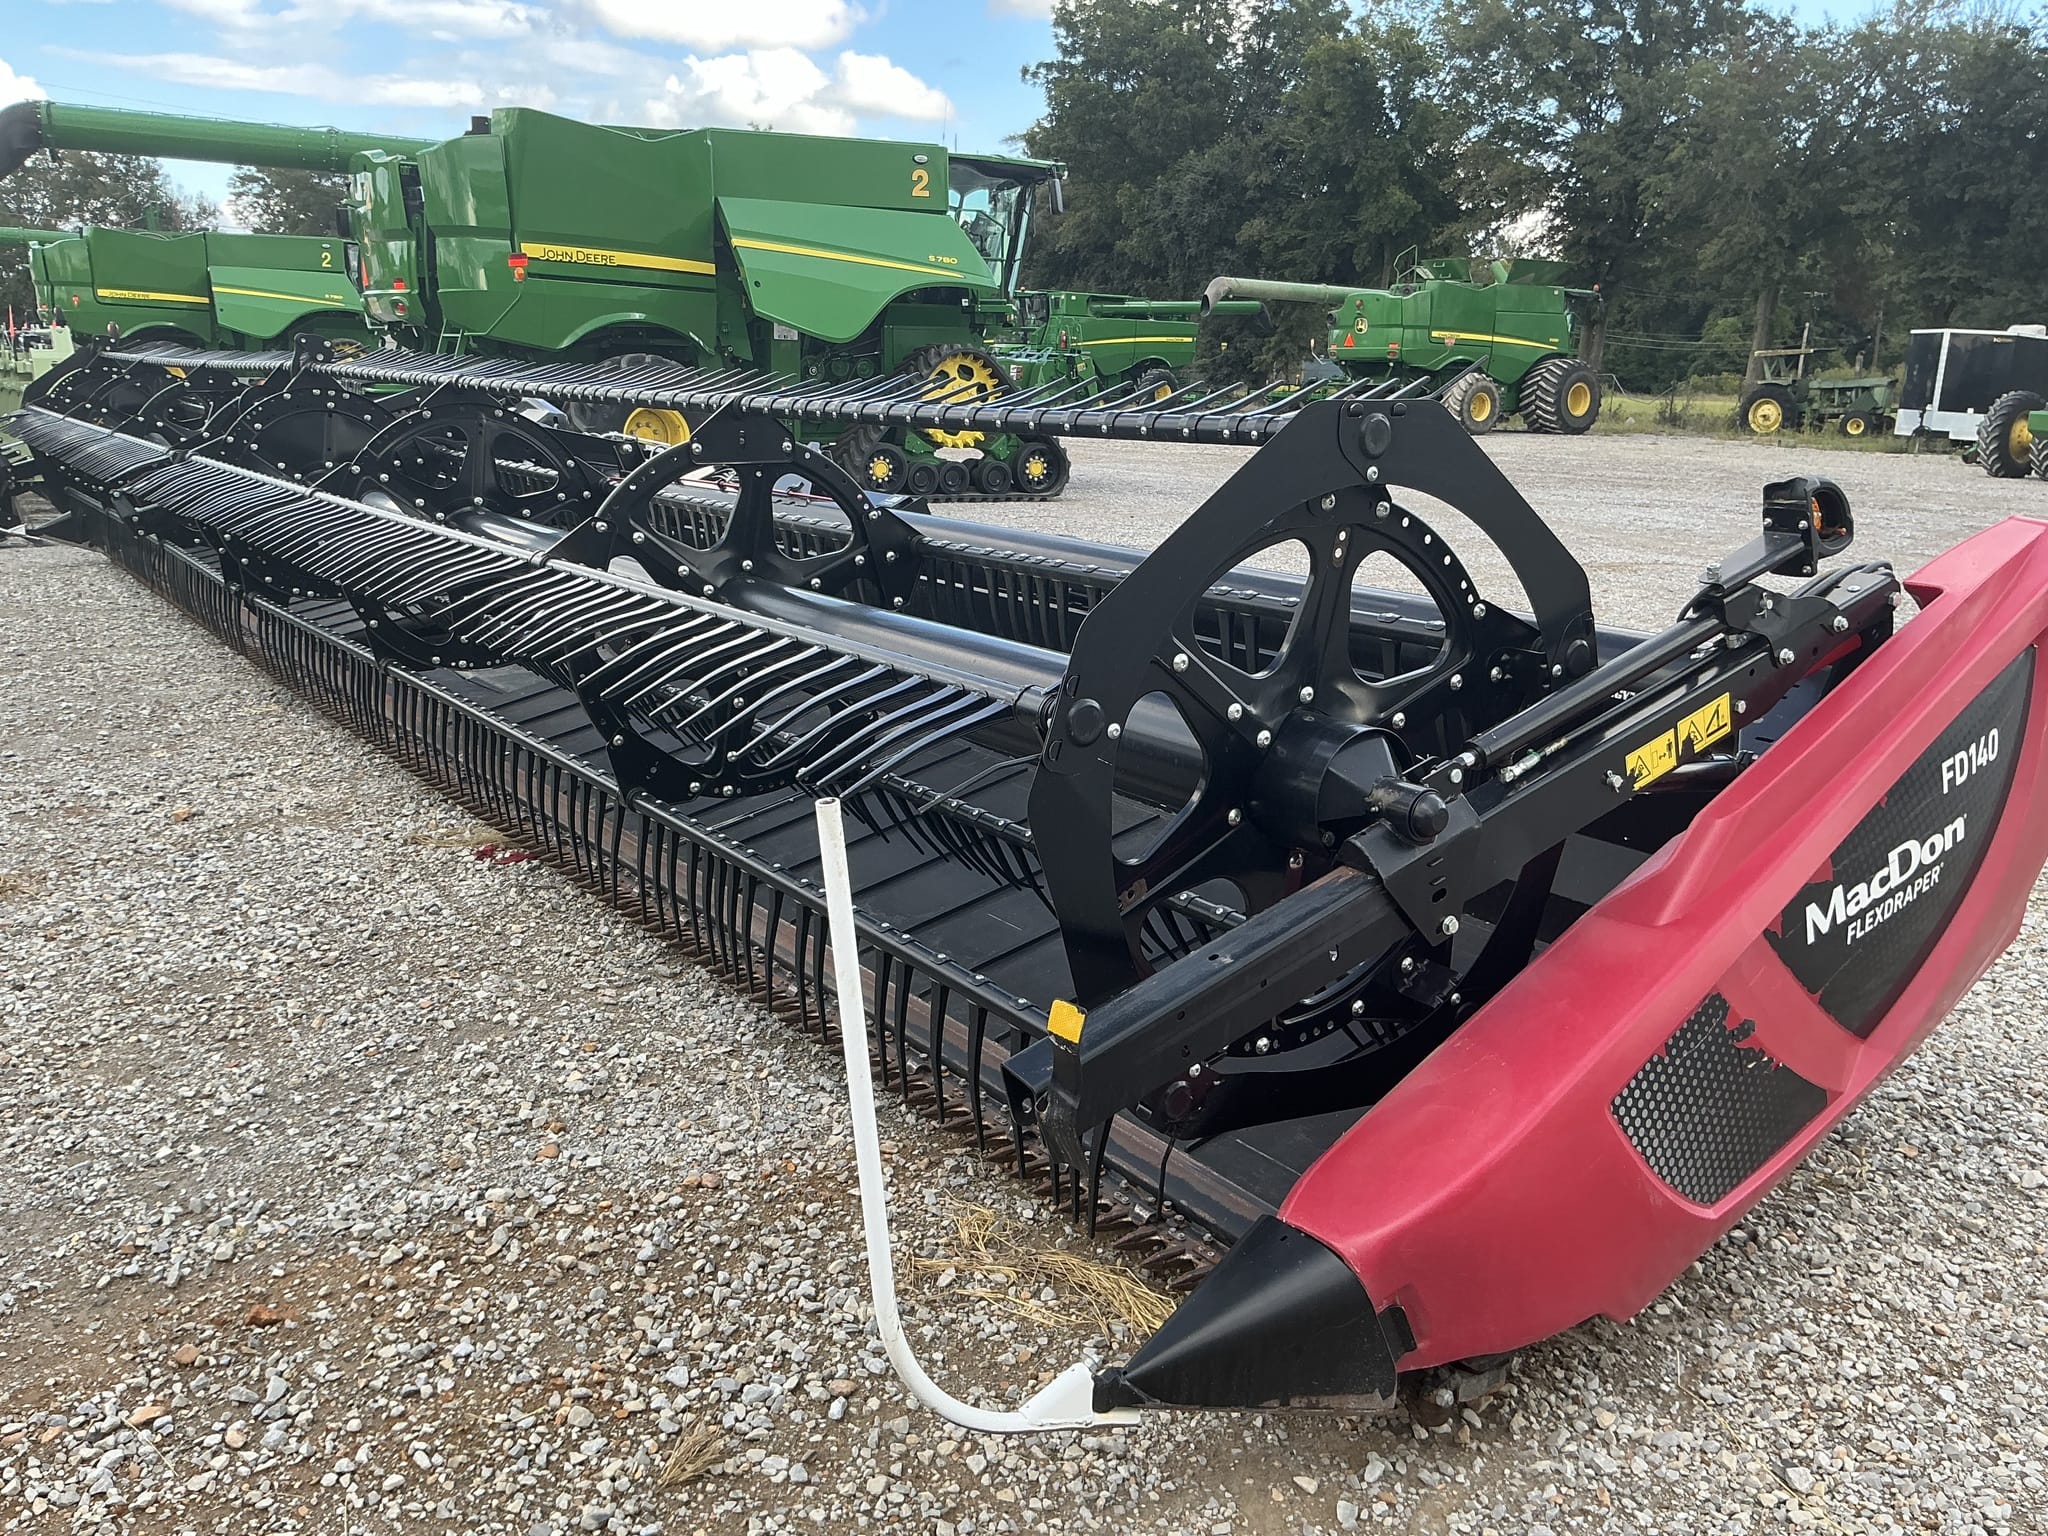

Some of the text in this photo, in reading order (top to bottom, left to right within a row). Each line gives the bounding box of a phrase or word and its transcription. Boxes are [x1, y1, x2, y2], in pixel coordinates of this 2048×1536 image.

[911, 168, 930, 197] 2
[321, 251, 332, 268] 2
[539, 247, 616, 264] JOHN DEERE
[1941, 727, 1999, 795] FD140
[1805, 815, 1967, 946] MacDon
[1846, 863, 1944, 946] FLEXDRAPER
